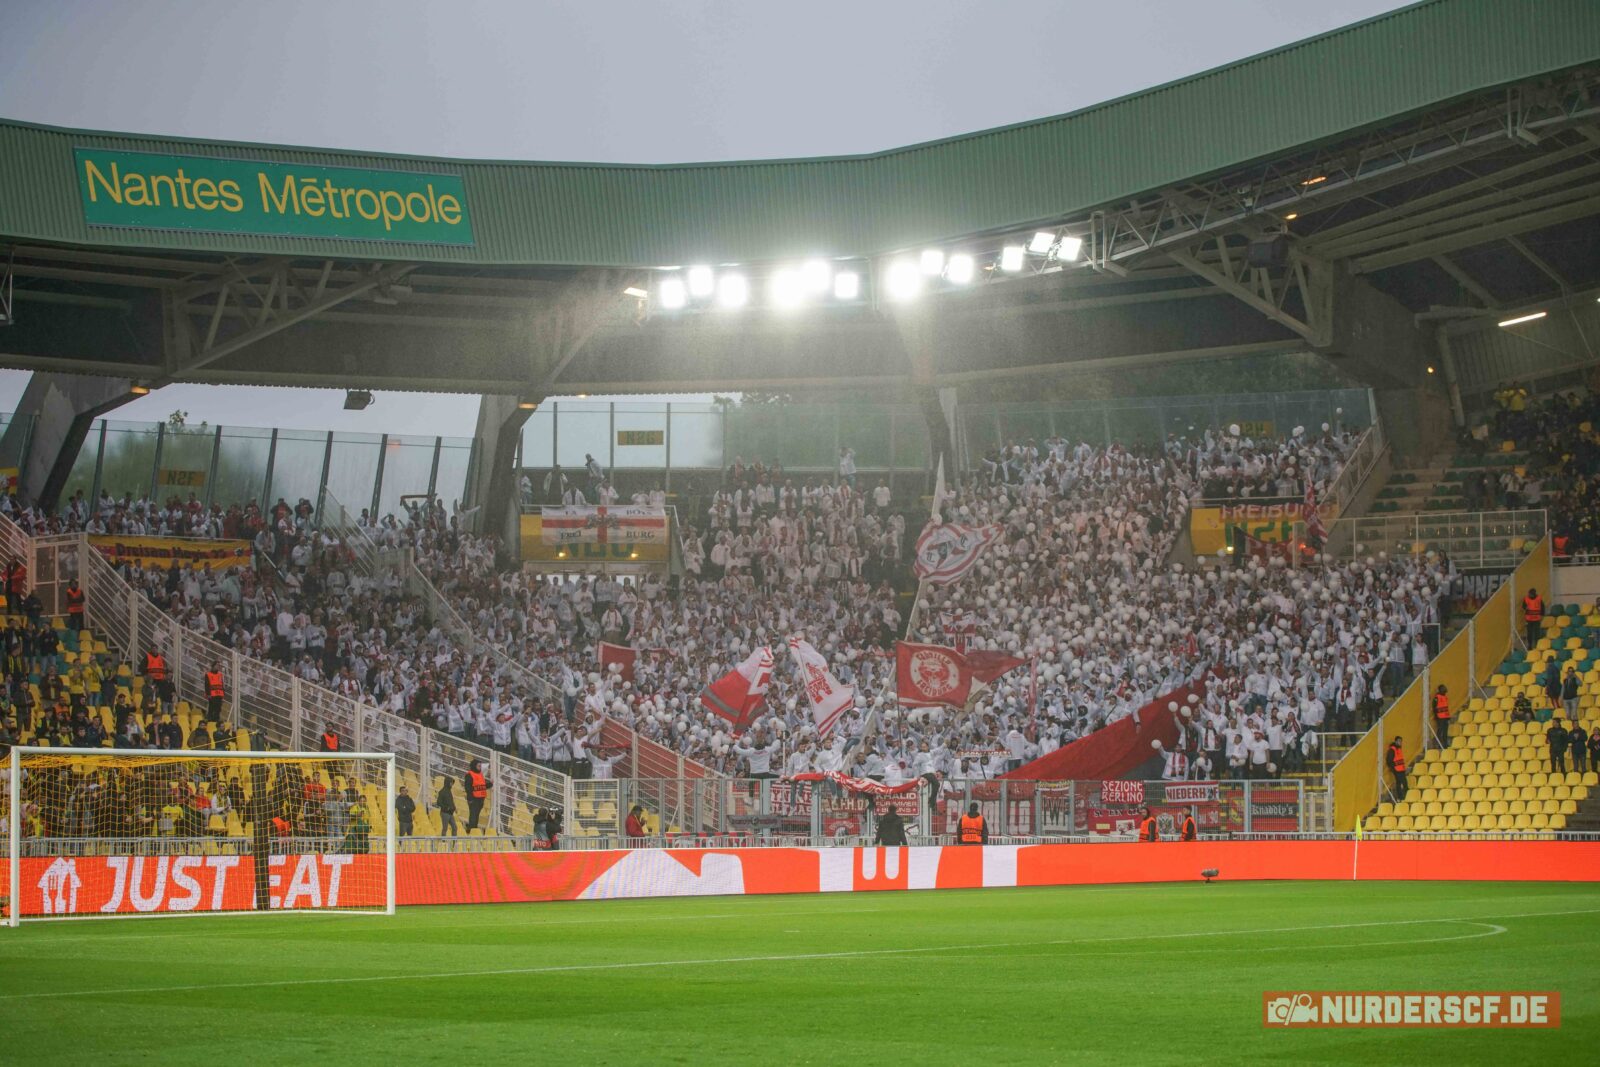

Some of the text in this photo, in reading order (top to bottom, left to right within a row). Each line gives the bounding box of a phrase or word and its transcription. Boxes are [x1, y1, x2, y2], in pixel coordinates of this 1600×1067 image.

[84, 159, 244, 213] Nantes
[1221, 503, 1331, 519] FREIBUG
[1102, 780, 1143, 792] SEZIONE
[1166, 786, 1218, 800] NIEDERHF
[1101, 791, 1143, 803] BERLINO
[99, 853, 354, 914] JUST EAT
